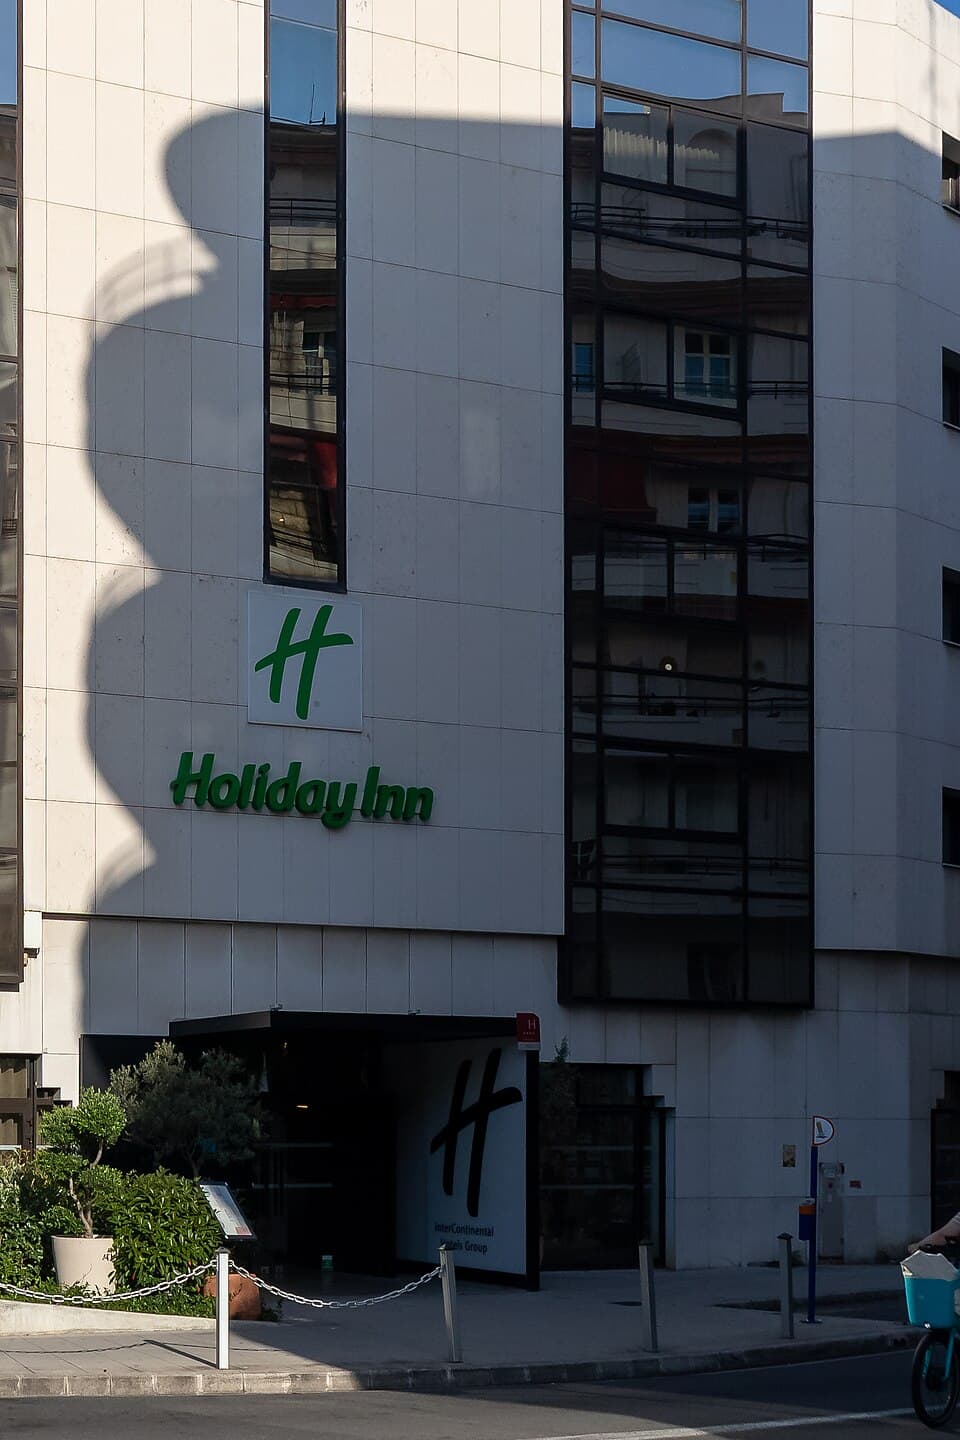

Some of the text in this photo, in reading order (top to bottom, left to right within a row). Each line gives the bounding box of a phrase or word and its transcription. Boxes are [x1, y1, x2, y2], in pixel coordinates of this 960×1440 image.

[255, 604, 354, 720] H
[171, 751, 434, 829] Holiday Inn
[434, 1221, 495, 1238] InterContinental
[465, 1241, 488, 1256] Group
